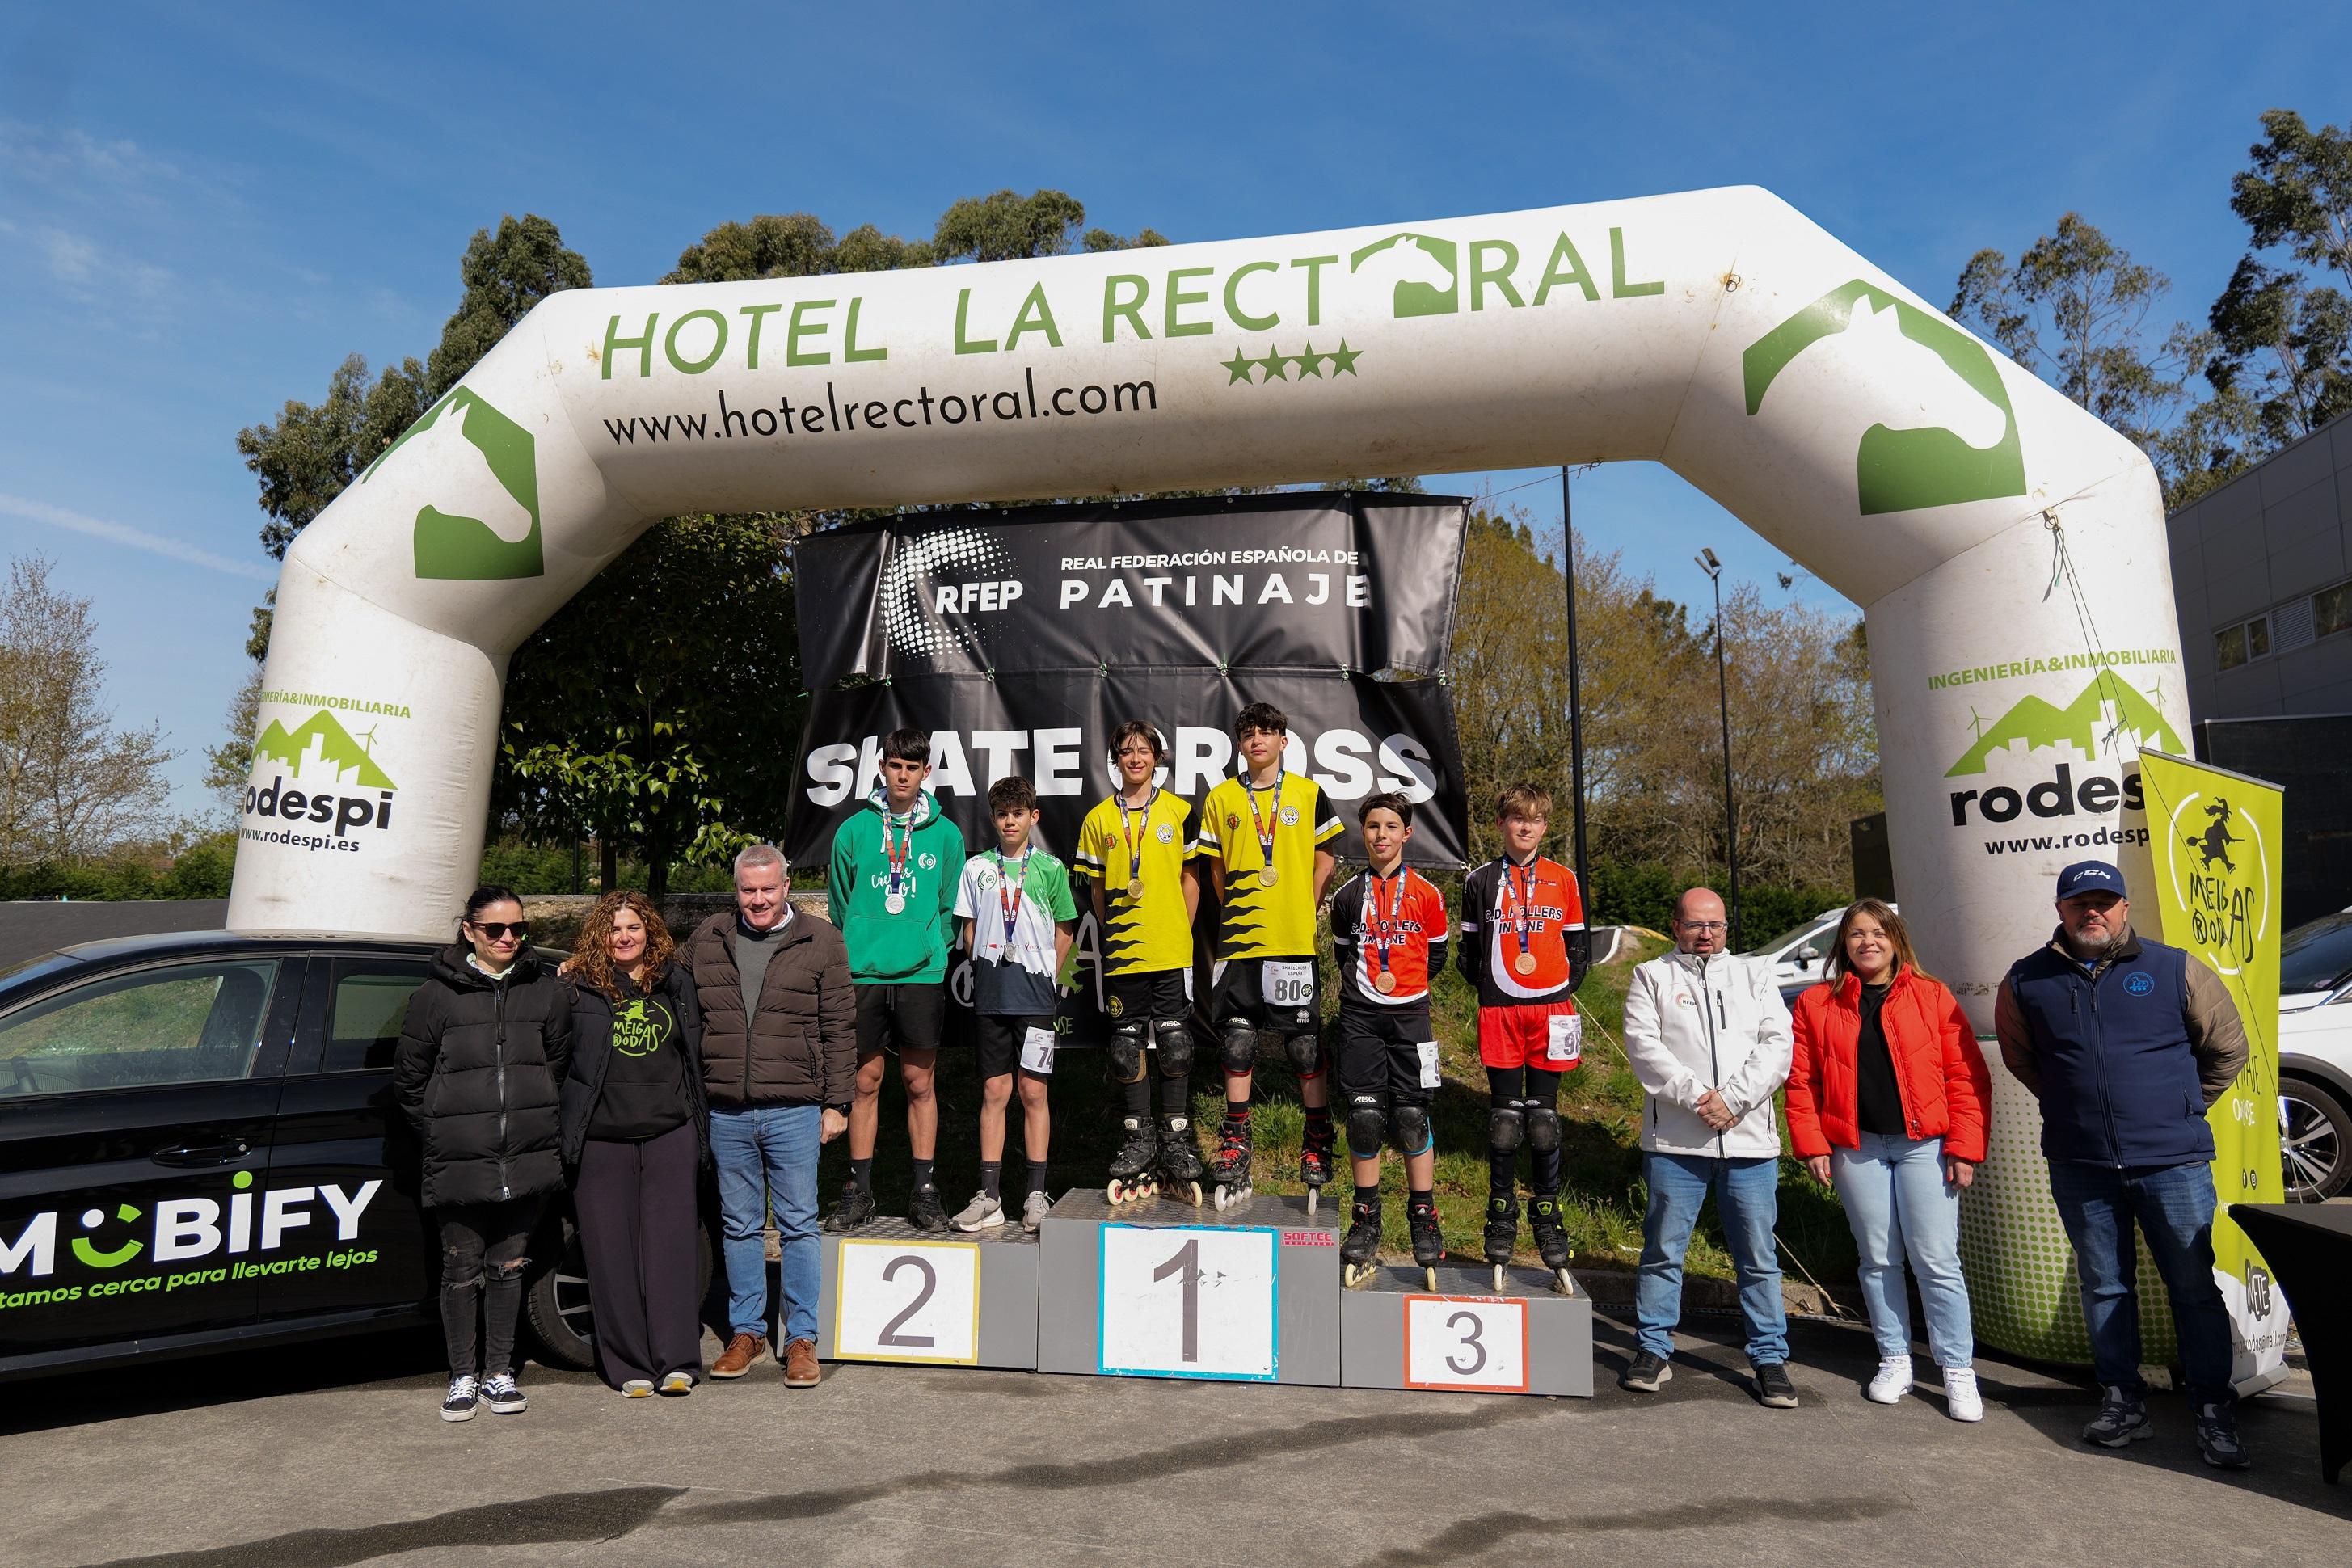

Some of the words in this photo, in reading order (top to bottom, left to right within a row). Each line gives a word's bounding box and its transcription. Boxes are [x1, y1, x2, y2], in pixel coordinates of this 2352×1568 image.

[601, 297, 887, 380] HOTEL
[954, 280, 1064, 355] LA
[604, 367, 1157, 445] www.hotelrectoral.com
[1061, 557, 1107, 571] REAL
[1111, 549, 1226, 569] FEDERACIÓN
[1231, 546, 1330, 564] ESPAÑOLA
[1334, 550, 1359, 565] DE
[935, 580, 1024, 614] RFEP
[1060, 573, 1369, 609] PATINAJE
[1928, 649, 2177, 690] INGENIERÍA&INMOBILIARIA
[245, 775, 394, 837] odespi
[1275, 979, 1301, 1001] 80
[88, 1276, 162, 1298] cerca
[166, 1267, 226, 1293] para
[231, 1254, 321, 1280] llevarte
[326, 1246, 379, 1270] lejos
[1153, 1238, 1199, 1362] 1
[878, 1255, 936, 1347] 2
[1444, 1311, 1487, 1376] 3
